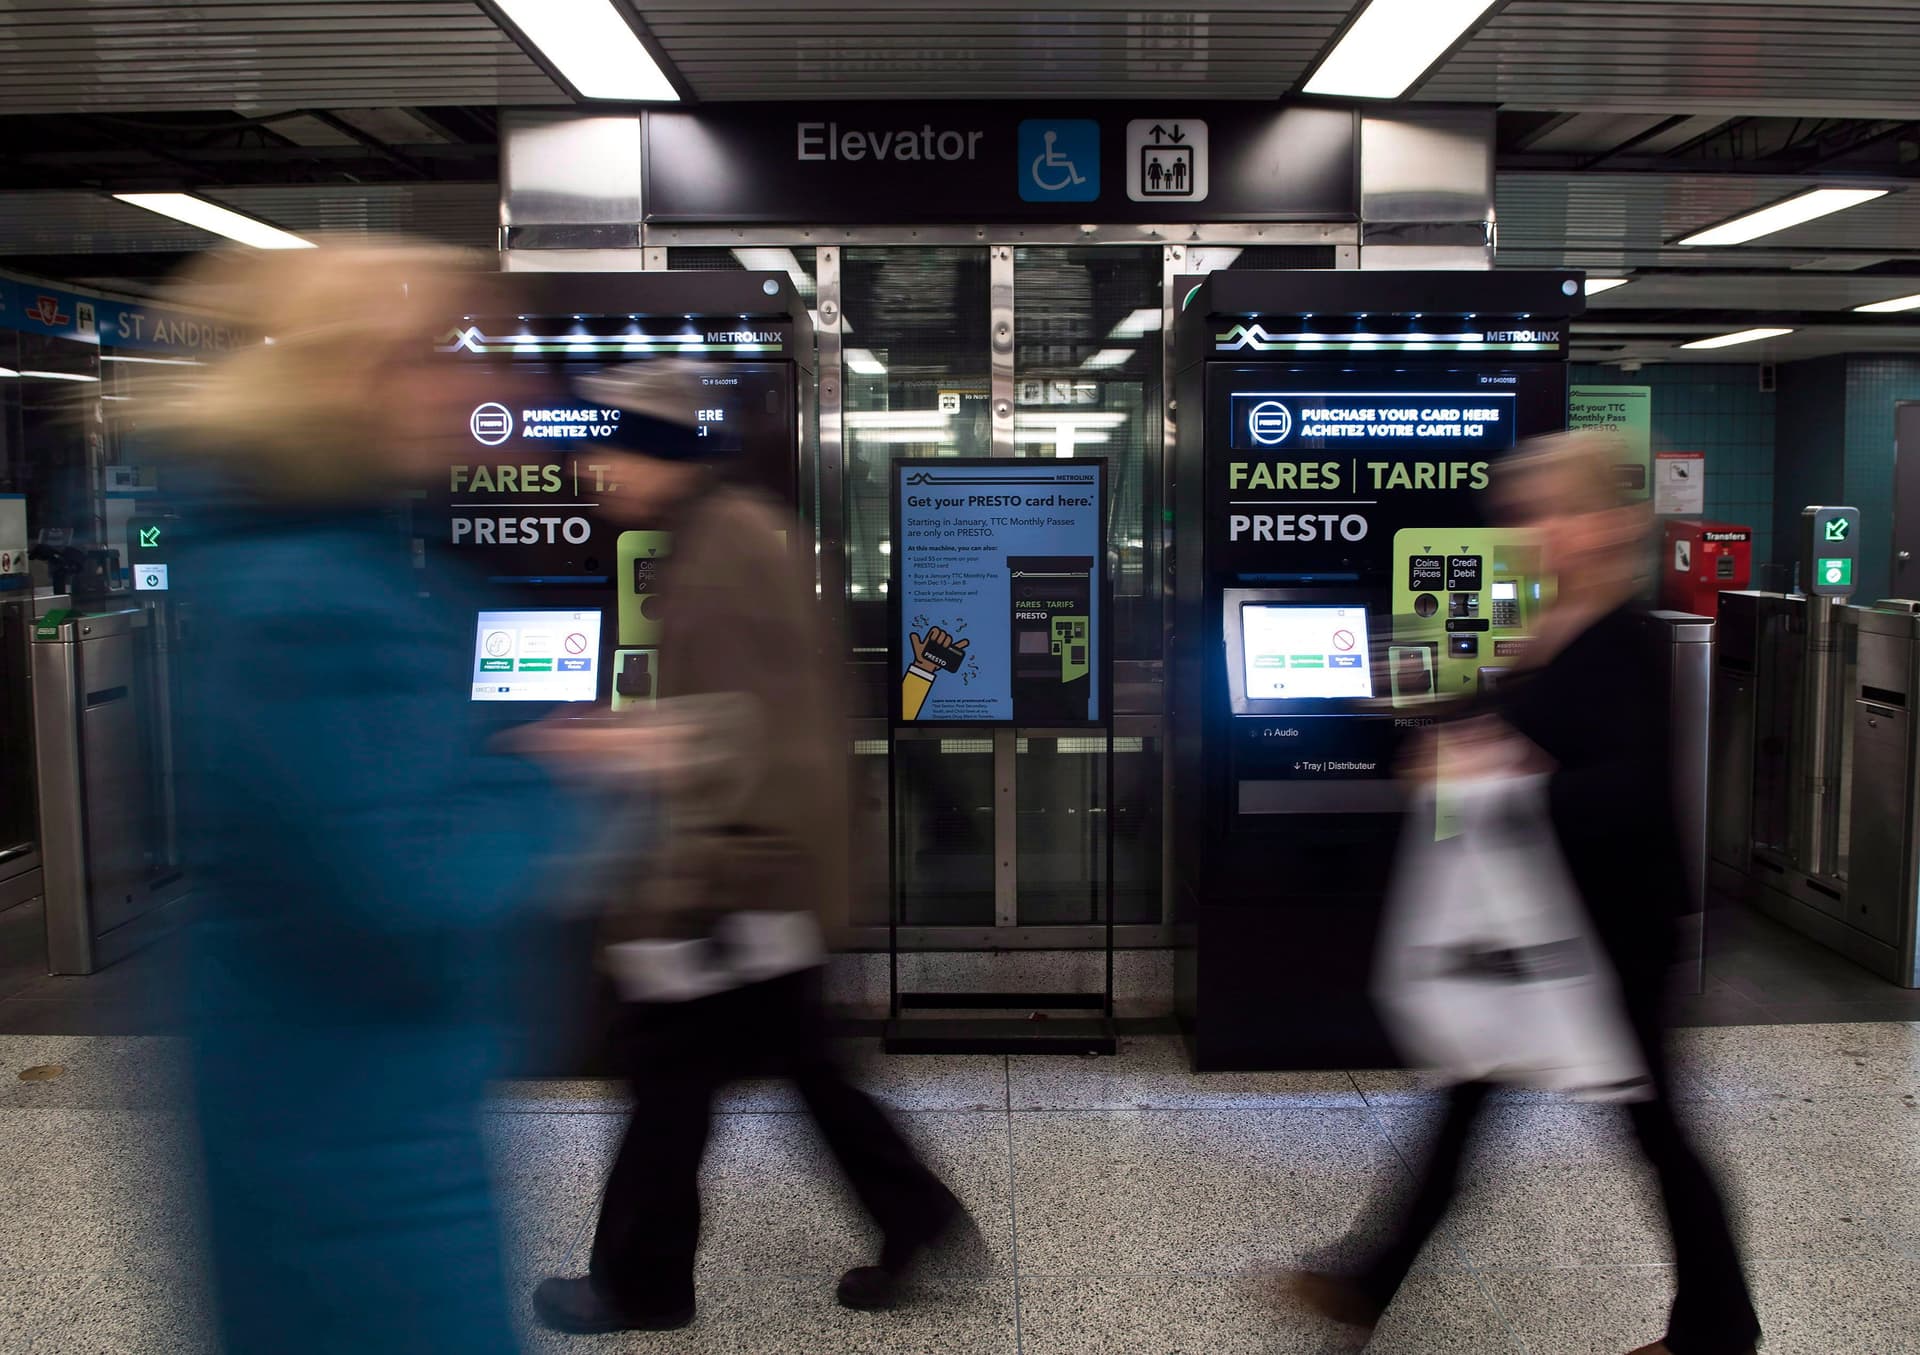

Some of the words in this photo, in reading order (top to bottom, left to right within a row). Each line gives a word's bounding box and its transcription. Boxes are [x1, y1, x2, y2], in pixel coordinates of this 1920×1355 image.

[797, 122, 983, 161] Elevator
[118, 311, 145, 341] ST
[707, 331, 782, 343] METROLINX
[1486, 330, 1560, 343] METROLINX
[1569, 403, 1584, 411] Get
[1586, 404, 1606, 413] your
[523, 409, 599, 422] PURCHASE
[694, 409, 724, 421] ERE
[1301, 408, 1376, 421] PURCHASE
[1378, 408, 1414, 421] YOUR
[1416, 408, 1460, 421] CARD
[1462, 408, 1500, 421] HERE
[1570, 413, 1606, 423] Monthly
[1607, 414, 1626, 422] Pass
[523, 425, 587, 437] ACHETEZ
[1301, 424, 1364, 437] ACHETEZ
[1367, 424, 1414, 437] VOTRE
[1416, 424, 1462, 437] CARTE
[1464, 424, 1483, 437] ICI
[450, 464, 562, 493] FARES
[1229, 461, 1341, 490] FARES
[1367, 461, 1489, 490] TARIFS
[907, 496, 931, 507] Get
[934, 498, 964, 510] your
[968, 496, 1022, 507] PRESTO
[1025, 495, 1054, 507] card
[907, 518, 941, 528] Starting
[942, 518, 951, 526] in
[952, 518, 988, 528] January,
[991, 518, 1008, 526] TTC
[1010, 518, 1044, 528] Monthly
[1046, 518, 1075, 526] Passes
[1229, 513, 1368, 542] PRESTO
[451, 517, 592, 545] PRESTO
[923, 528, 942, 539] only
[957, 528, 994, 537] PRESTO.
[1706, 532, 1746, 540] Transfers
[1416, 558, 1439, 566] Coins
[1452, 558, 1477, 566] Credit
[1414, 570, 1440, 578] Pièces
[1454, 570, 1476, 578] Debit
[924, 652, 947, 666] PRESTO
[1394, 718, 1434, 727] PRESTO
[1274, 728, 1299, 737] Audio
[1302, 762, 1321, 772] Tray
[1328, 762, 1376, 770] Distributeur
